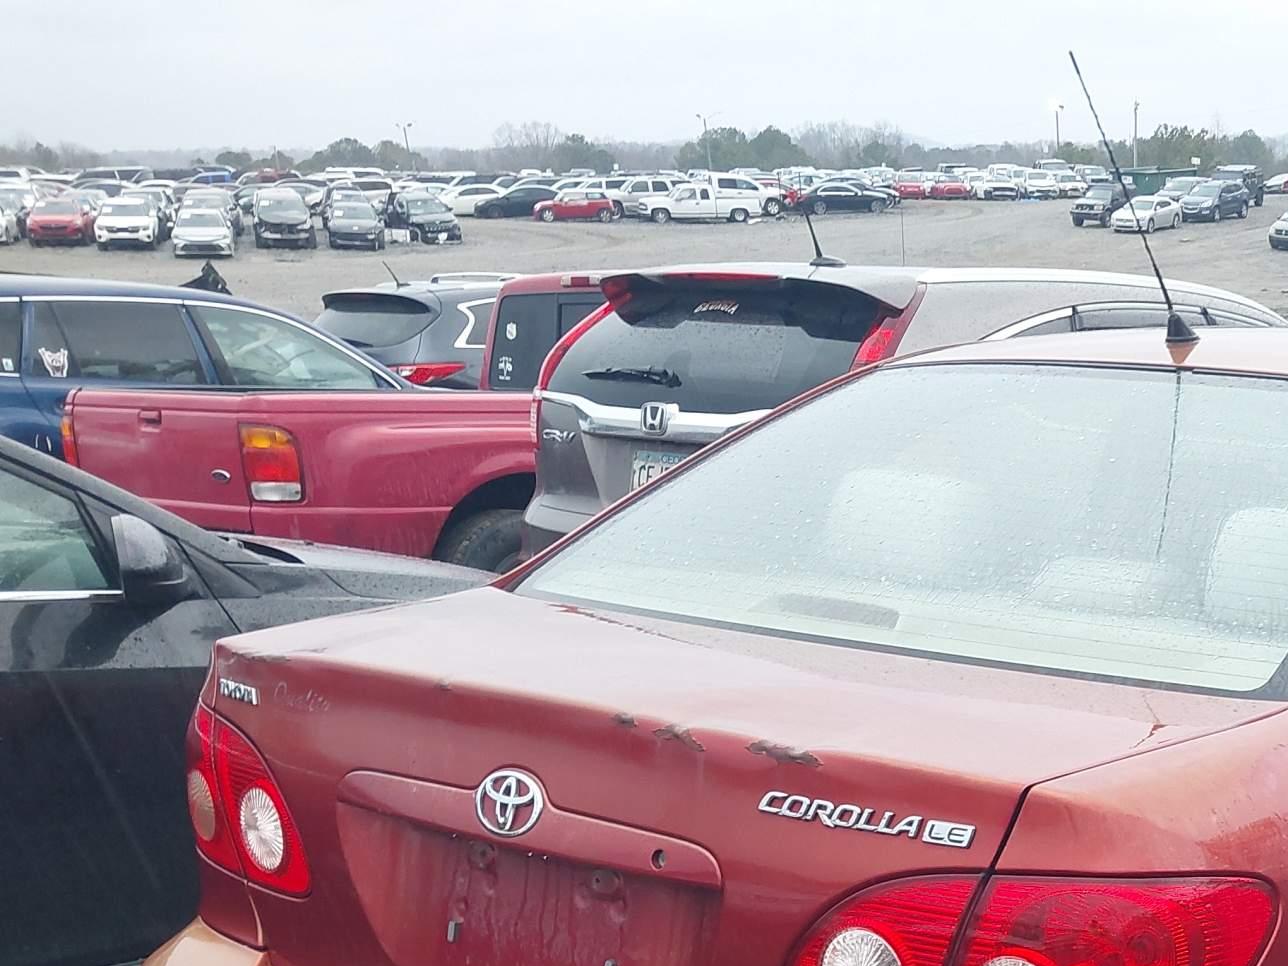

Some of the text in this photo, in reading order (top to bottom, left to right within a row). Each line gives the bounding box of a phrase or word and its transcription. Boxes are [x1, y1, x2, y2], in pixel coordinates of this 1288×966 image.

[219, 678, 259, 706] TOYOTA
[758, 791, 971, 846] COROLLA LE
